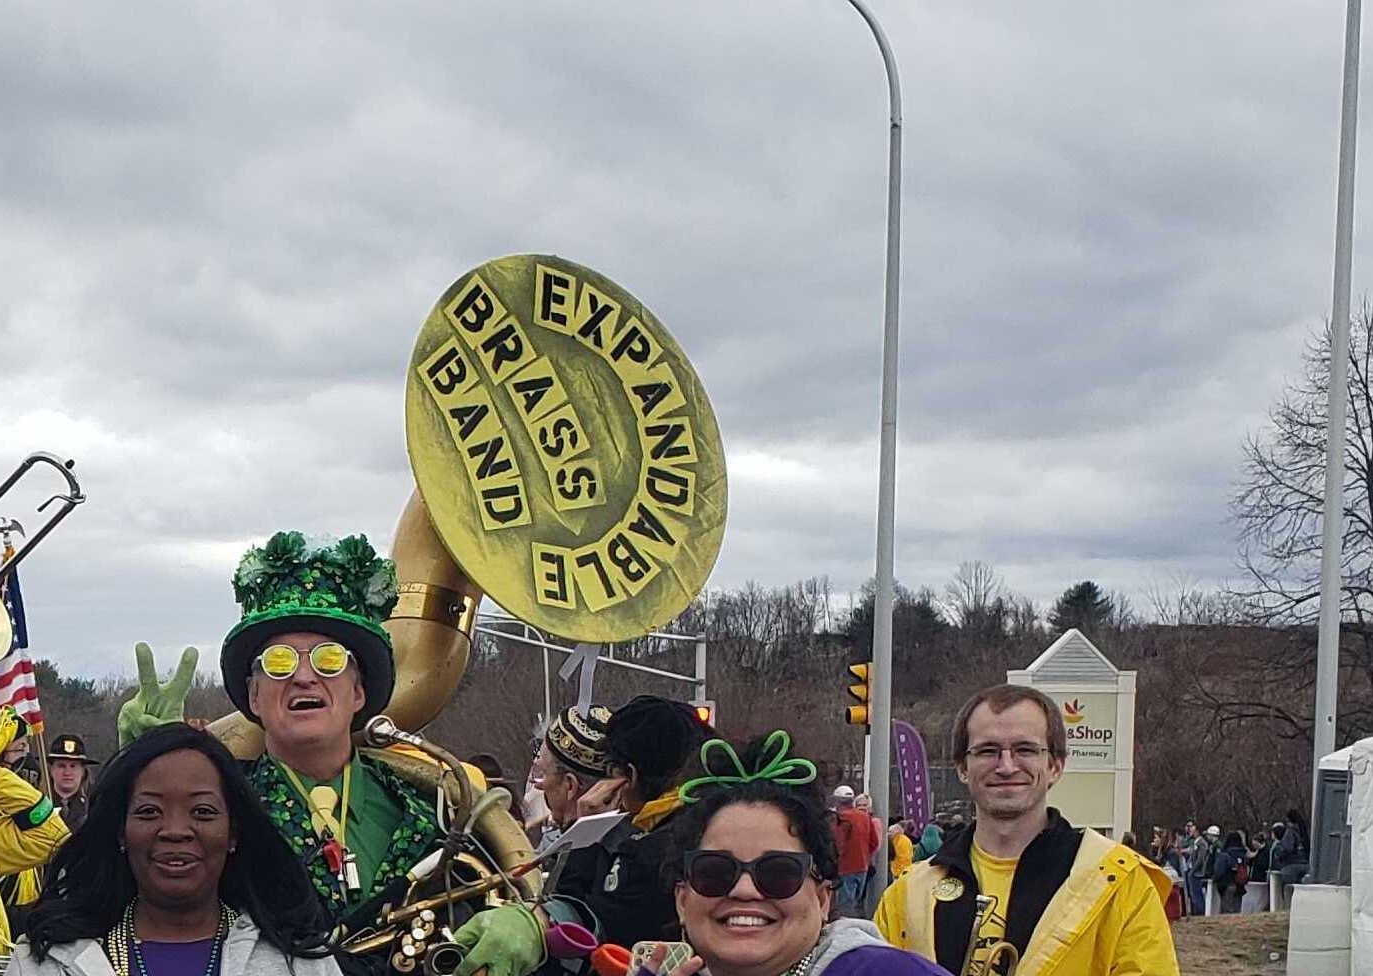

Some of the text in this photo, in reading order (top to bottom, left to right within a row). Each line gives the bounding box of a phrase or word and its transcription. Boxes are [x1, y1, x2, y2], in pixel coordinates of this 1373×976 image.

[427, 346, 523, 522] BAND
[453, 284, 597, 501] BRASS
[540, 273, 691, 603] EXPANDABLE
[1072, 749, 1109, 759] Pharmacy
